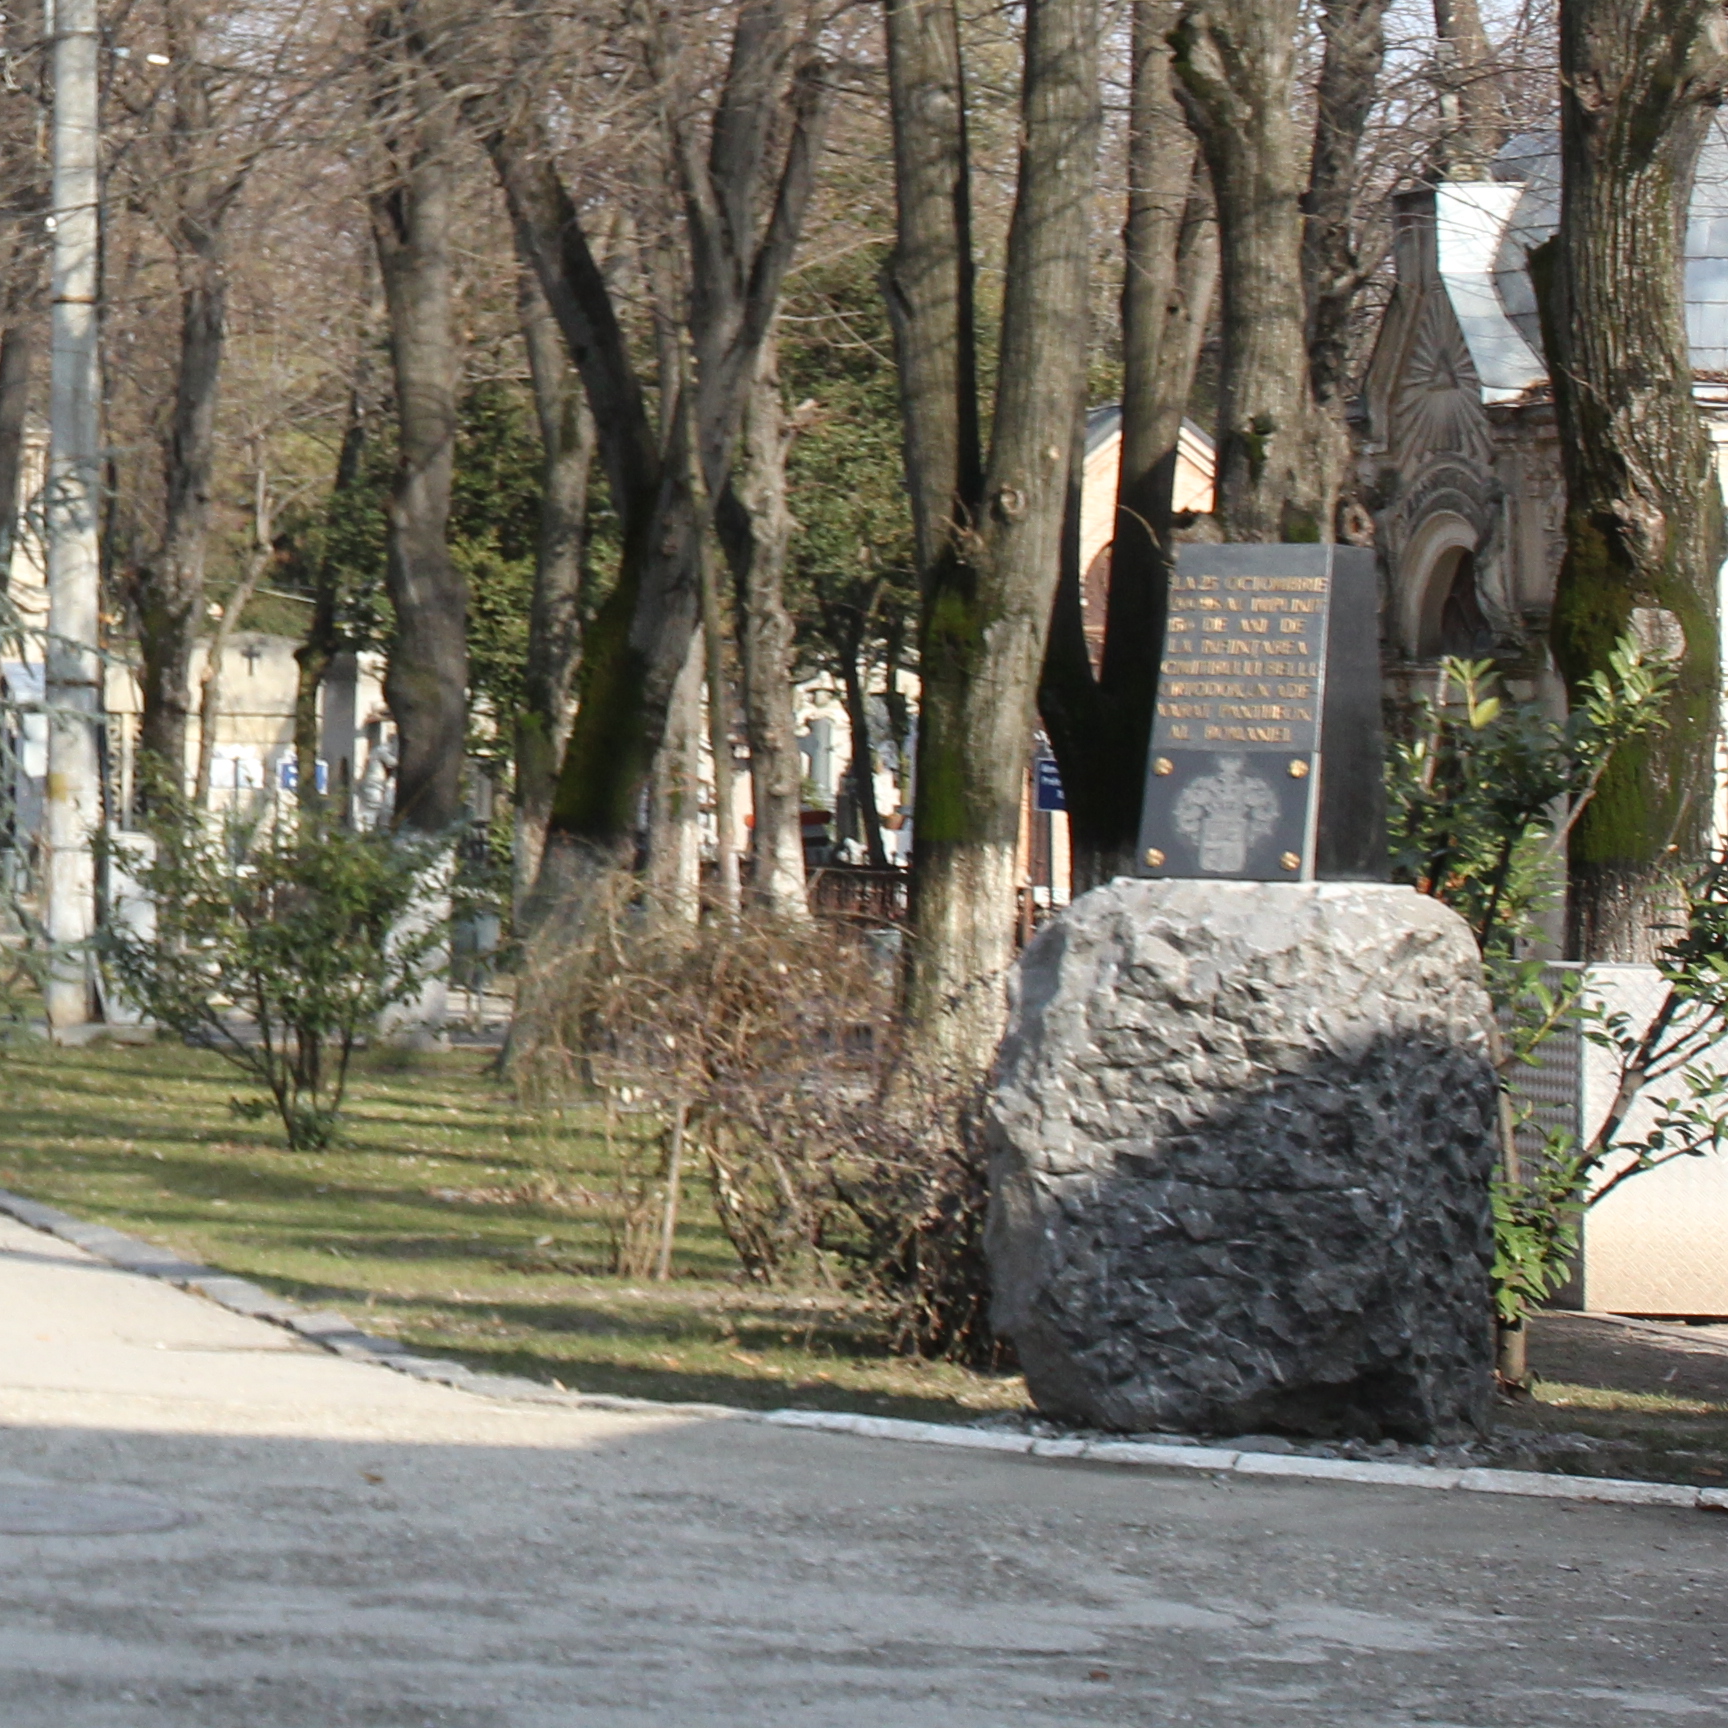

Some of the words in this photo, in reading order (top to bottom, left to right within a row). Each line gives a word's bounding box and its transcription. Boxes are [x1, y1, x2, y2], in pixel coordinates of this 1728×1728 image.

[1202, 617, 1228, 633] DE
[1279, 618, 1307, 634] DE
[1167, 638, 1193, 654] LA
